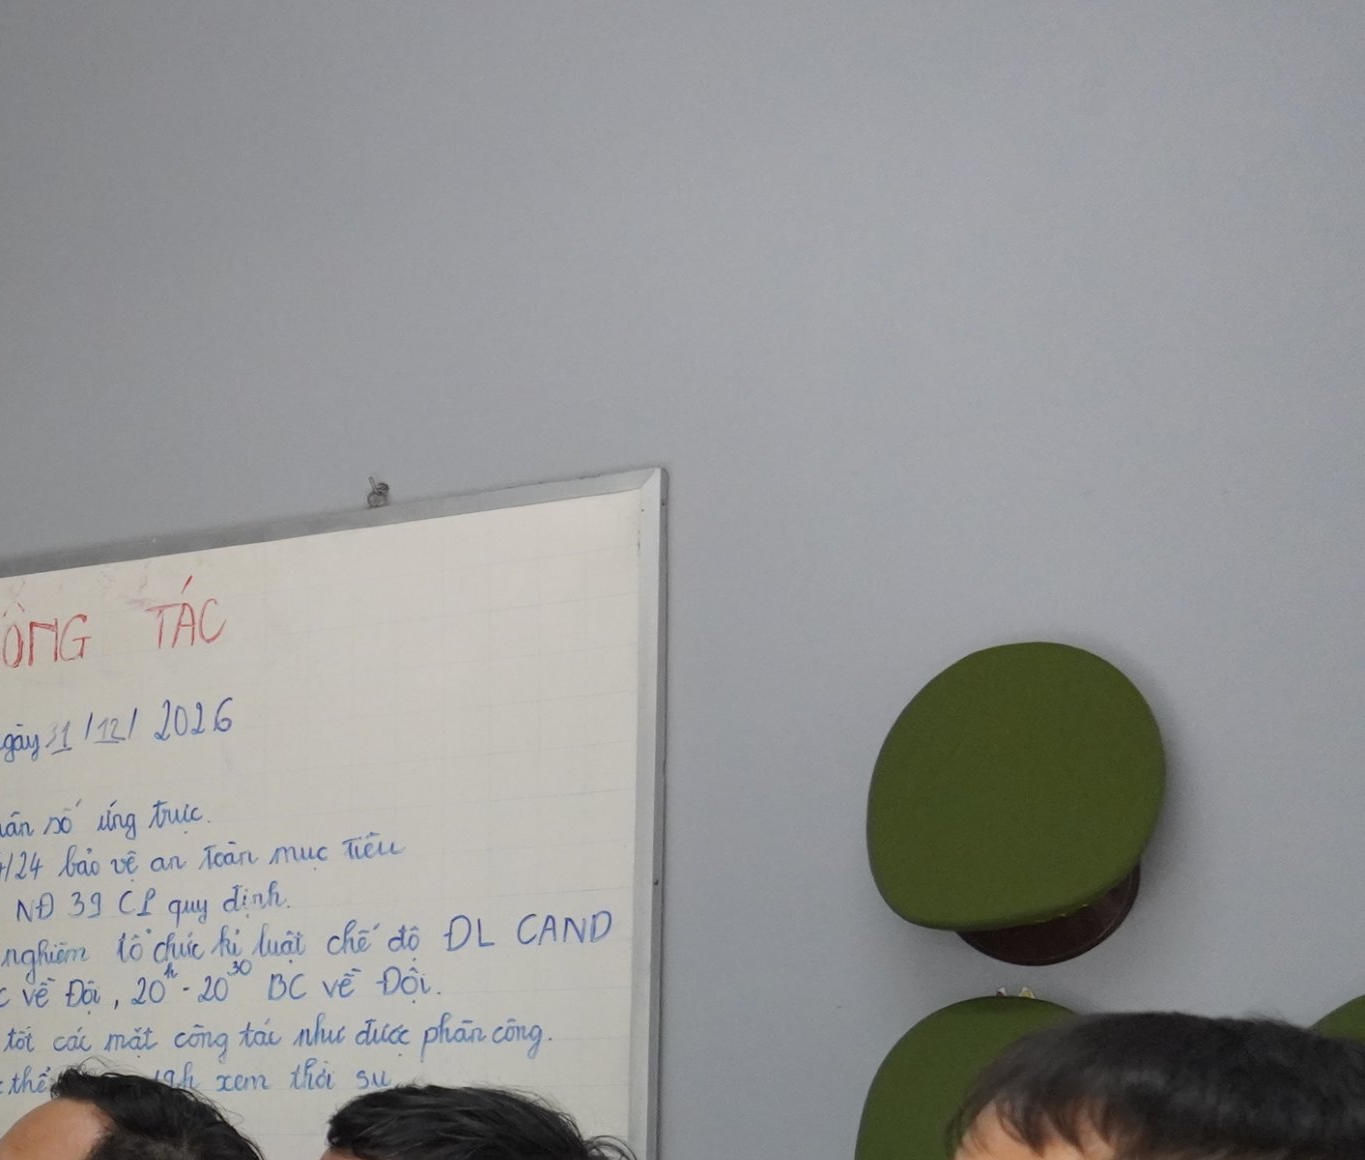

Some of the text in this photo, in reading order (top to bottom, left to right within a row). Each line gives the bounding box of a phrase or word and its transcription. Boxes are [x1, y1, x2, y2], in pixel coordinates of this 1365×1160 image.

[145, 575, 227, 650] TÁC
[154, 697, 234, 742] 2026
[58, 844, 101, 878] bảo
[150, 855, 187, 873] an
[16, 897, 55, 923] NĐ
[69, 892, 102, 918] 39
[167, 896, 209, 926] quy
[1, 939, 91, 986] nghiêm
[327, 919, 380, 956] chế
[387, 924, 421, 963] độ
[516, 909, 613, 947] CAND
[22, 977, 56, 1008] về
[267, 973, 308, 1000] BC
[322, 968, 362, 998] về
[3, 1025, 35, 1053] tốt
[53, 1025, 92, 1052] các
[103, 1025, 160, 1059] mặt
[174, 1023, 229, 1064] công
[238, 1017, 282, 1048] tác
[419, 1012, 486, 1062] phân
[216, 1074, 270, 1092] xem
